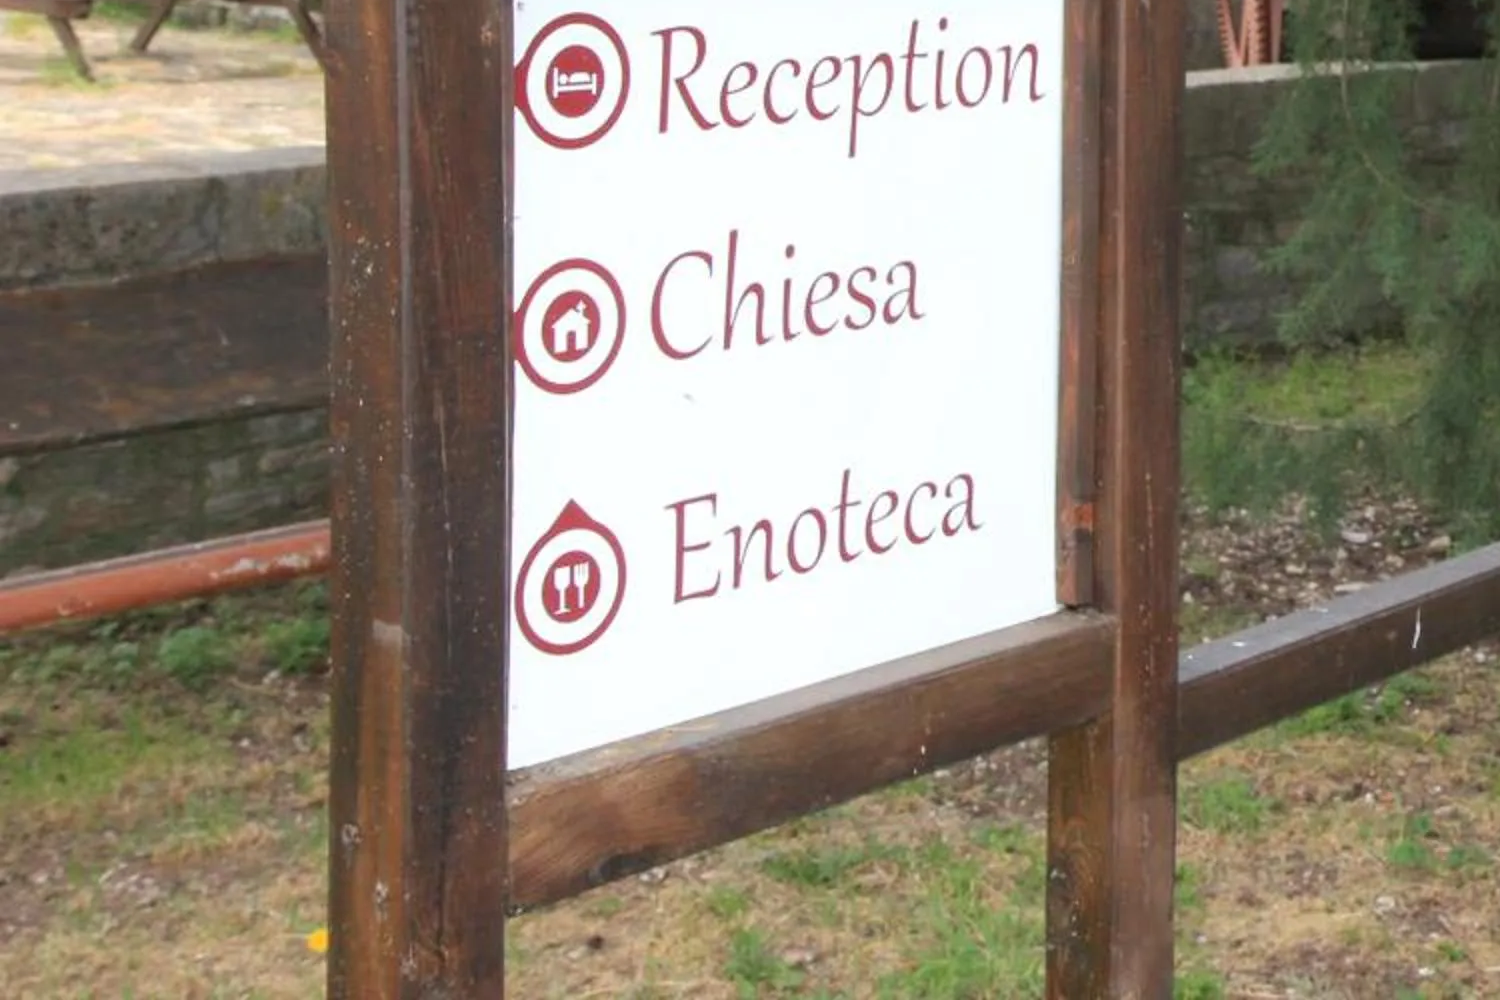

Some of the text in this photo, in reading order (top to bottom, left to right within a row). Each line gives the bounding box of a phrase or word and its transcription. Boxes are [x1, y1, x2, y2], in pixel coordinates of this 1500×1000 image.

[650, 17, 1044, 158] Reception
[650, 229, 924, 361] Chiesa
[665, 468, 983, 604] Enoteca
